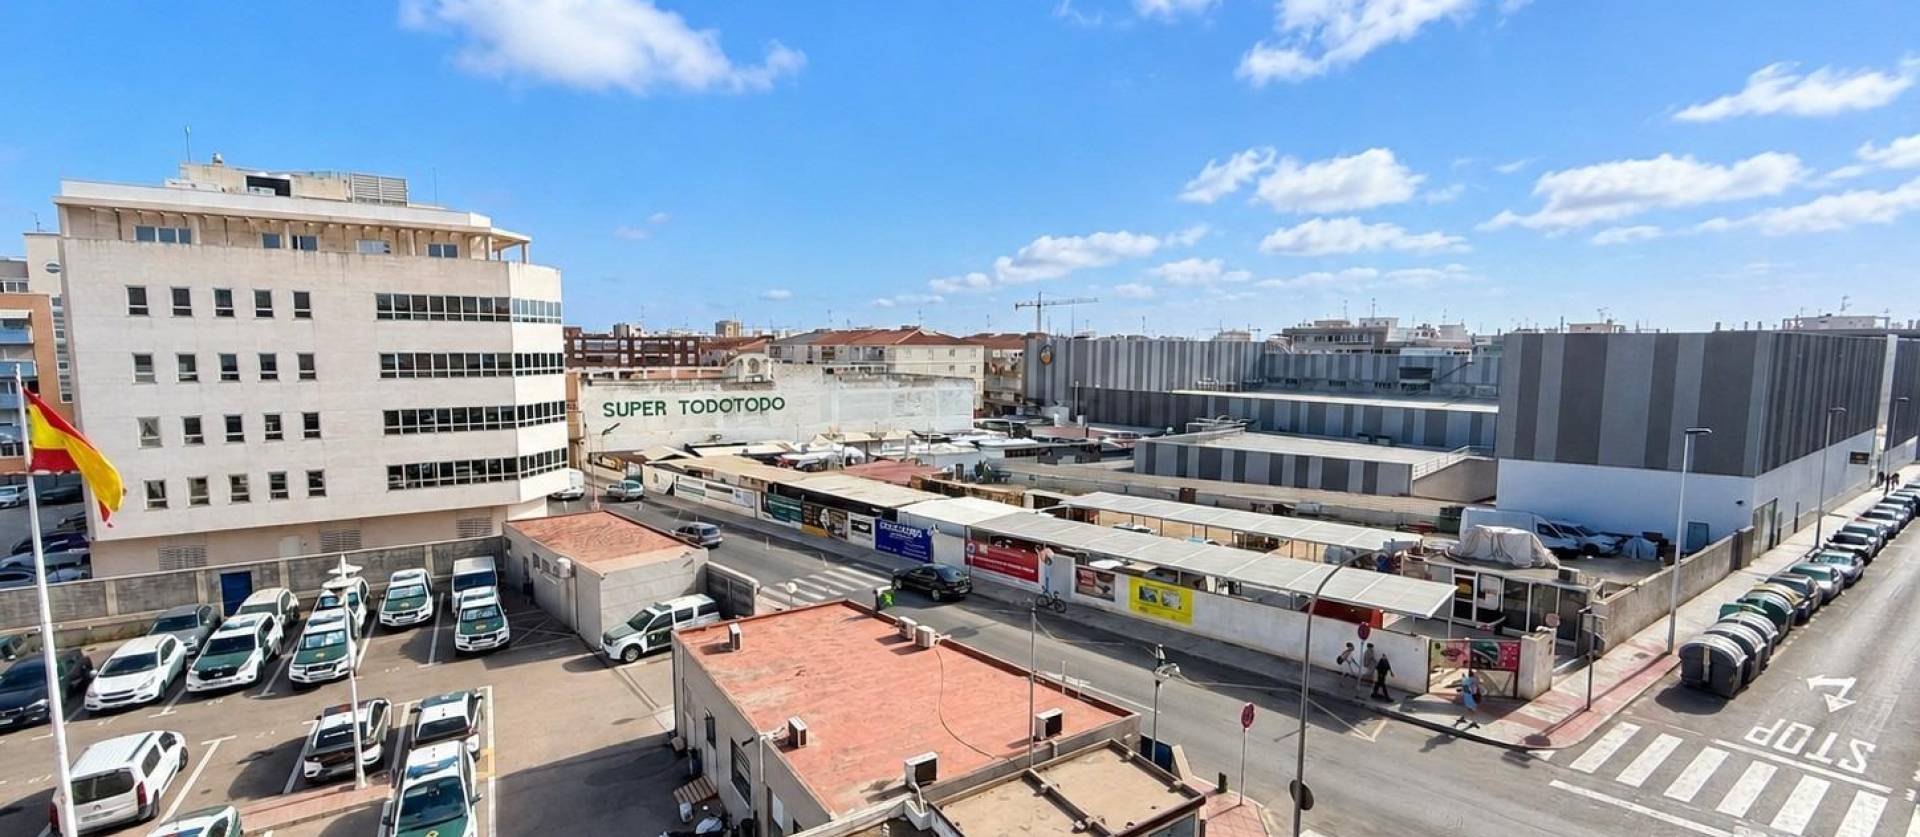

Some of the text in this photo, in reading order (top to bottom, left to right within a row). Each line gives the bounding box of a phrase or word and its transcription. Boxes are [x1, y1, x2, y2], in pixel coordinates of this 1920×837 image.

[602, 397, 786, 417] SUPER TODOTODO
[1744, 718, 1877, 774] STOP
